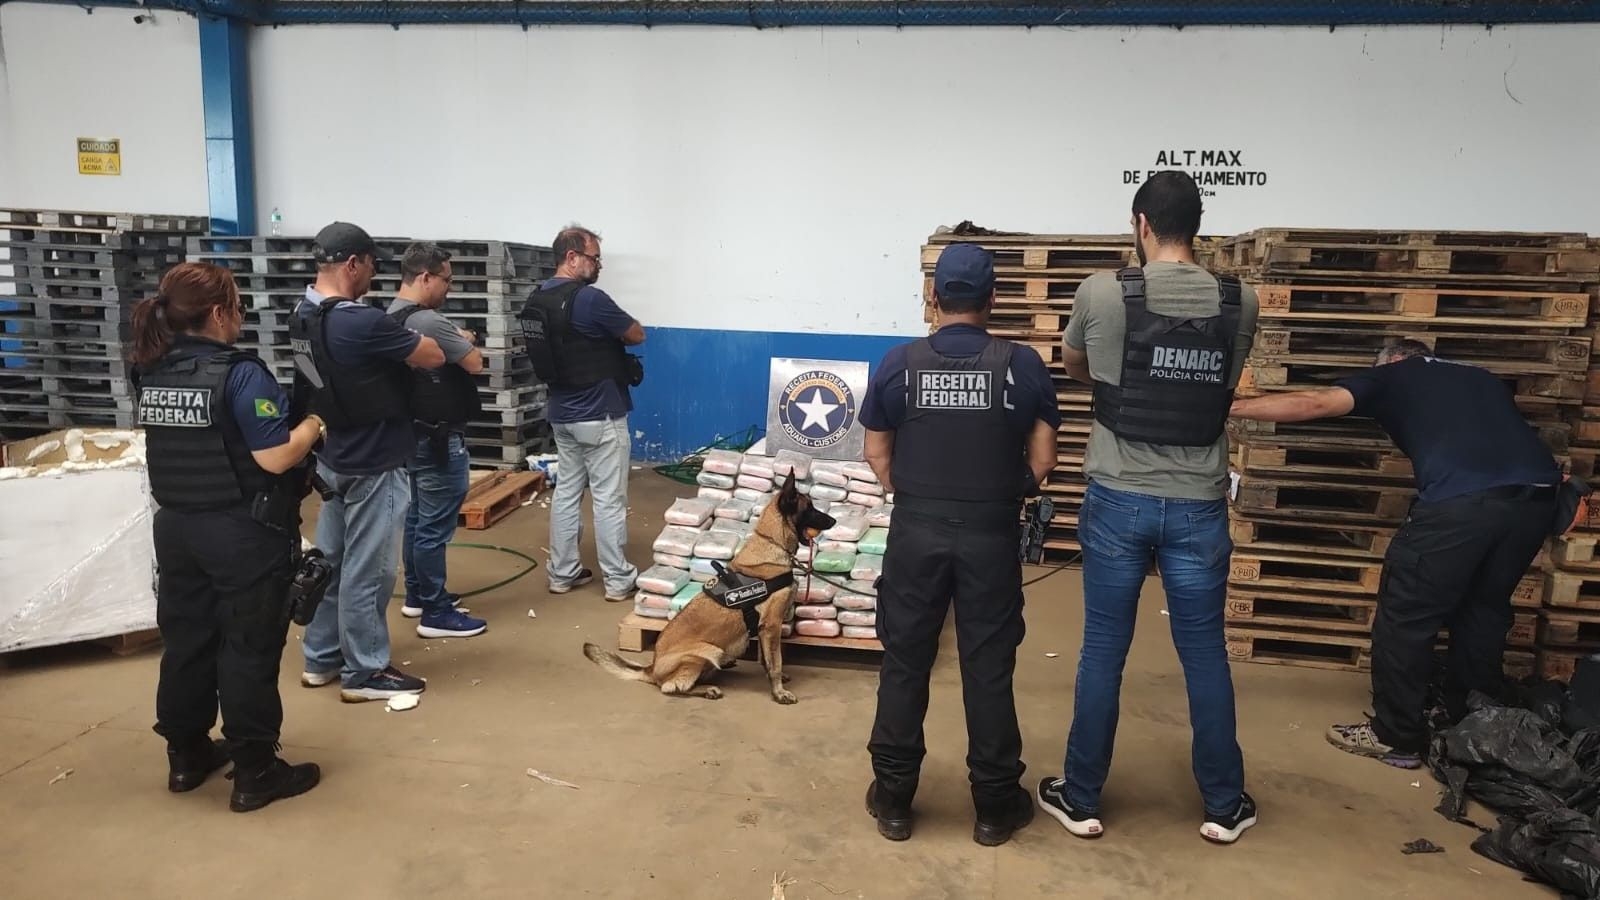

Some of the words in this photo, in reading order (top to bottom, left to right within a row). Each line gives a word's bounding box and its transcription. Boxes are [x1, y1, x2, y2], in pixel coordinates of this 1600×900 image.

[80, 142, 116, 152] CUIDADO
[1123, 170, 1140, 184] DE
[1152, 346, 1223, 370] DENARC
[784, 372, 816, 394] RECEITA
[818, 372, 850, 398] FEDERAL
[922, 374, 986, 390] RECEITA
[1194, 372, 1221, 382] CIVIL
[142, 390, 204, 408] RECEITA
[922, 390, 988, 406] FEDERAL
[140, 406, 208, 424] FEDERAL
[782, 423, 808, 446] ADUANA
[814, 427, 847, 446] CUSTOMS
[1234, 602, 1250, 612] PBR
